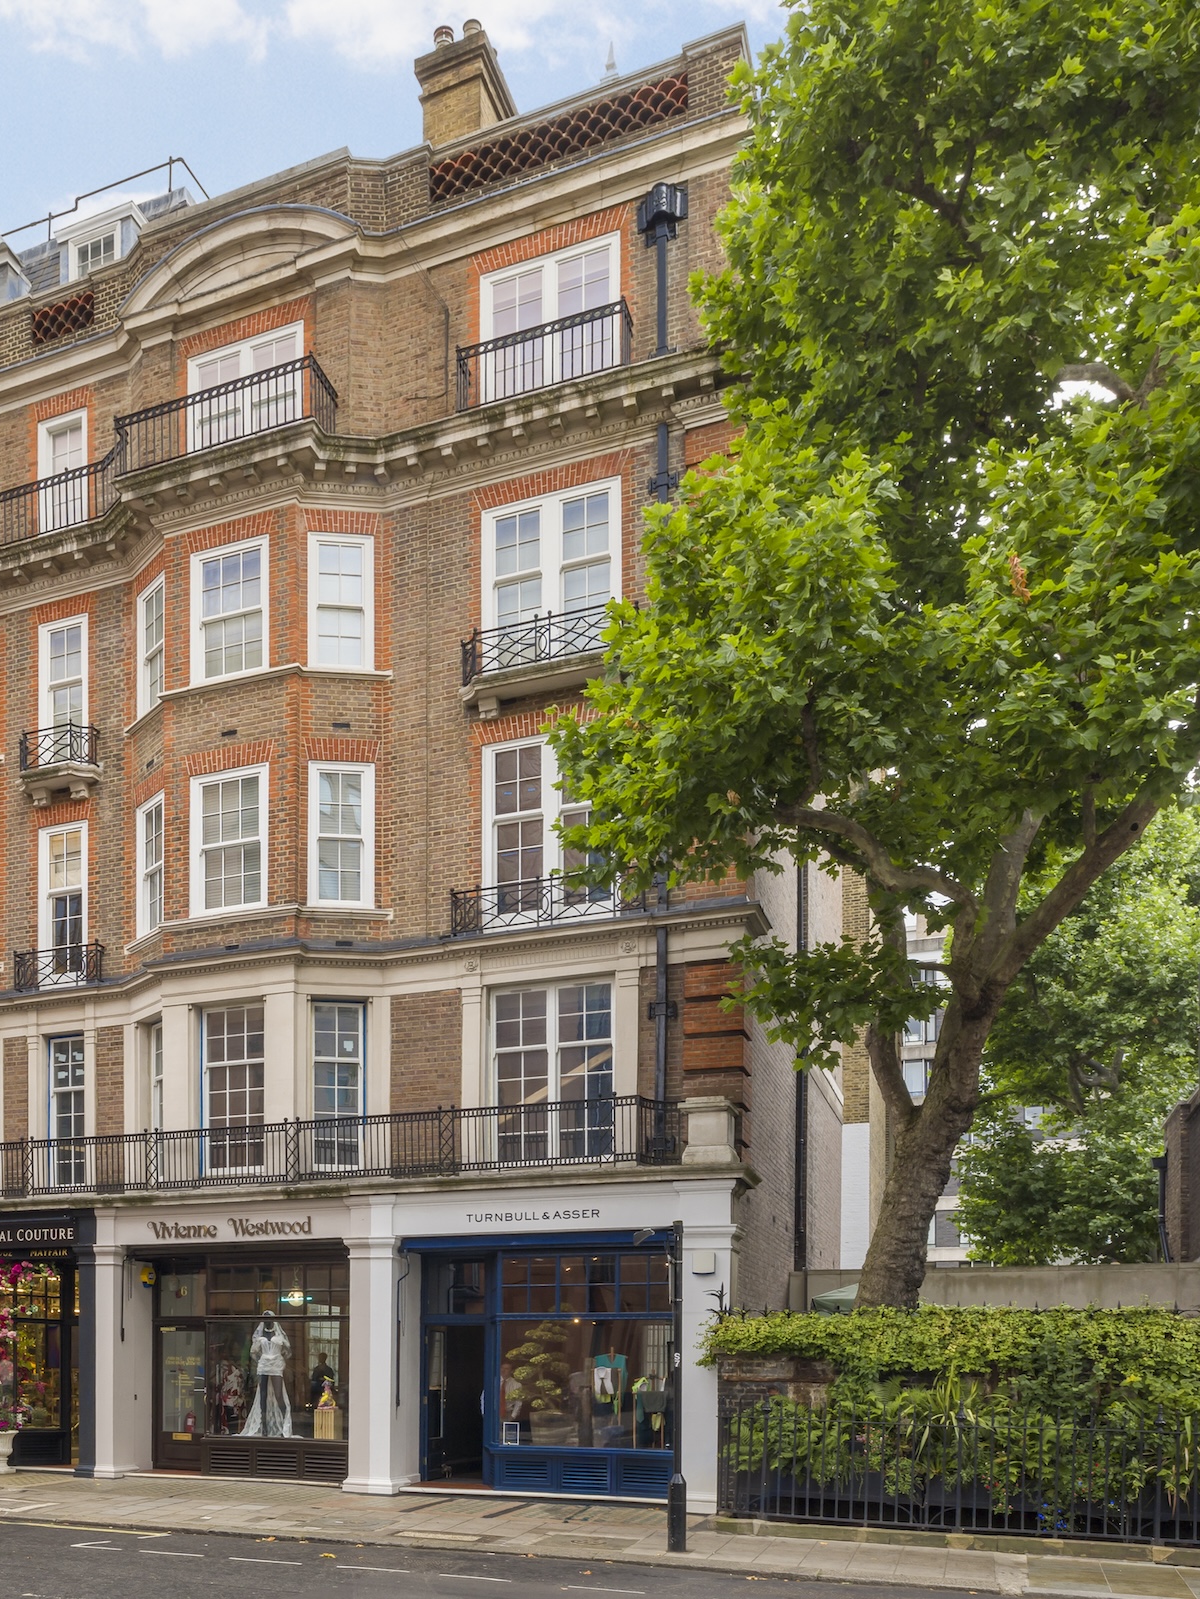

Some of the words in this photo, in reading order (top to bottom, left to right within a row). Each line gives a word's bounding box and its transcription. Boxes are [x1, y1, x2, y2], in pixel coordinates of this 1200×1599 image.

[466, 1211, 539, 1223] TURNBULL
[542, 1211, 550, 1220] &
[553, 1208, 600, 1220] ASSER
[16, 1227, 74, 1241] COUTURE
[147, 1221, 218, 1239] Vivienne
[227, 1216, 312, 1237] Westwood
[29, 1248, 68, 1257] MAYFAIR
[180, 1285, 188, 1297] 6
